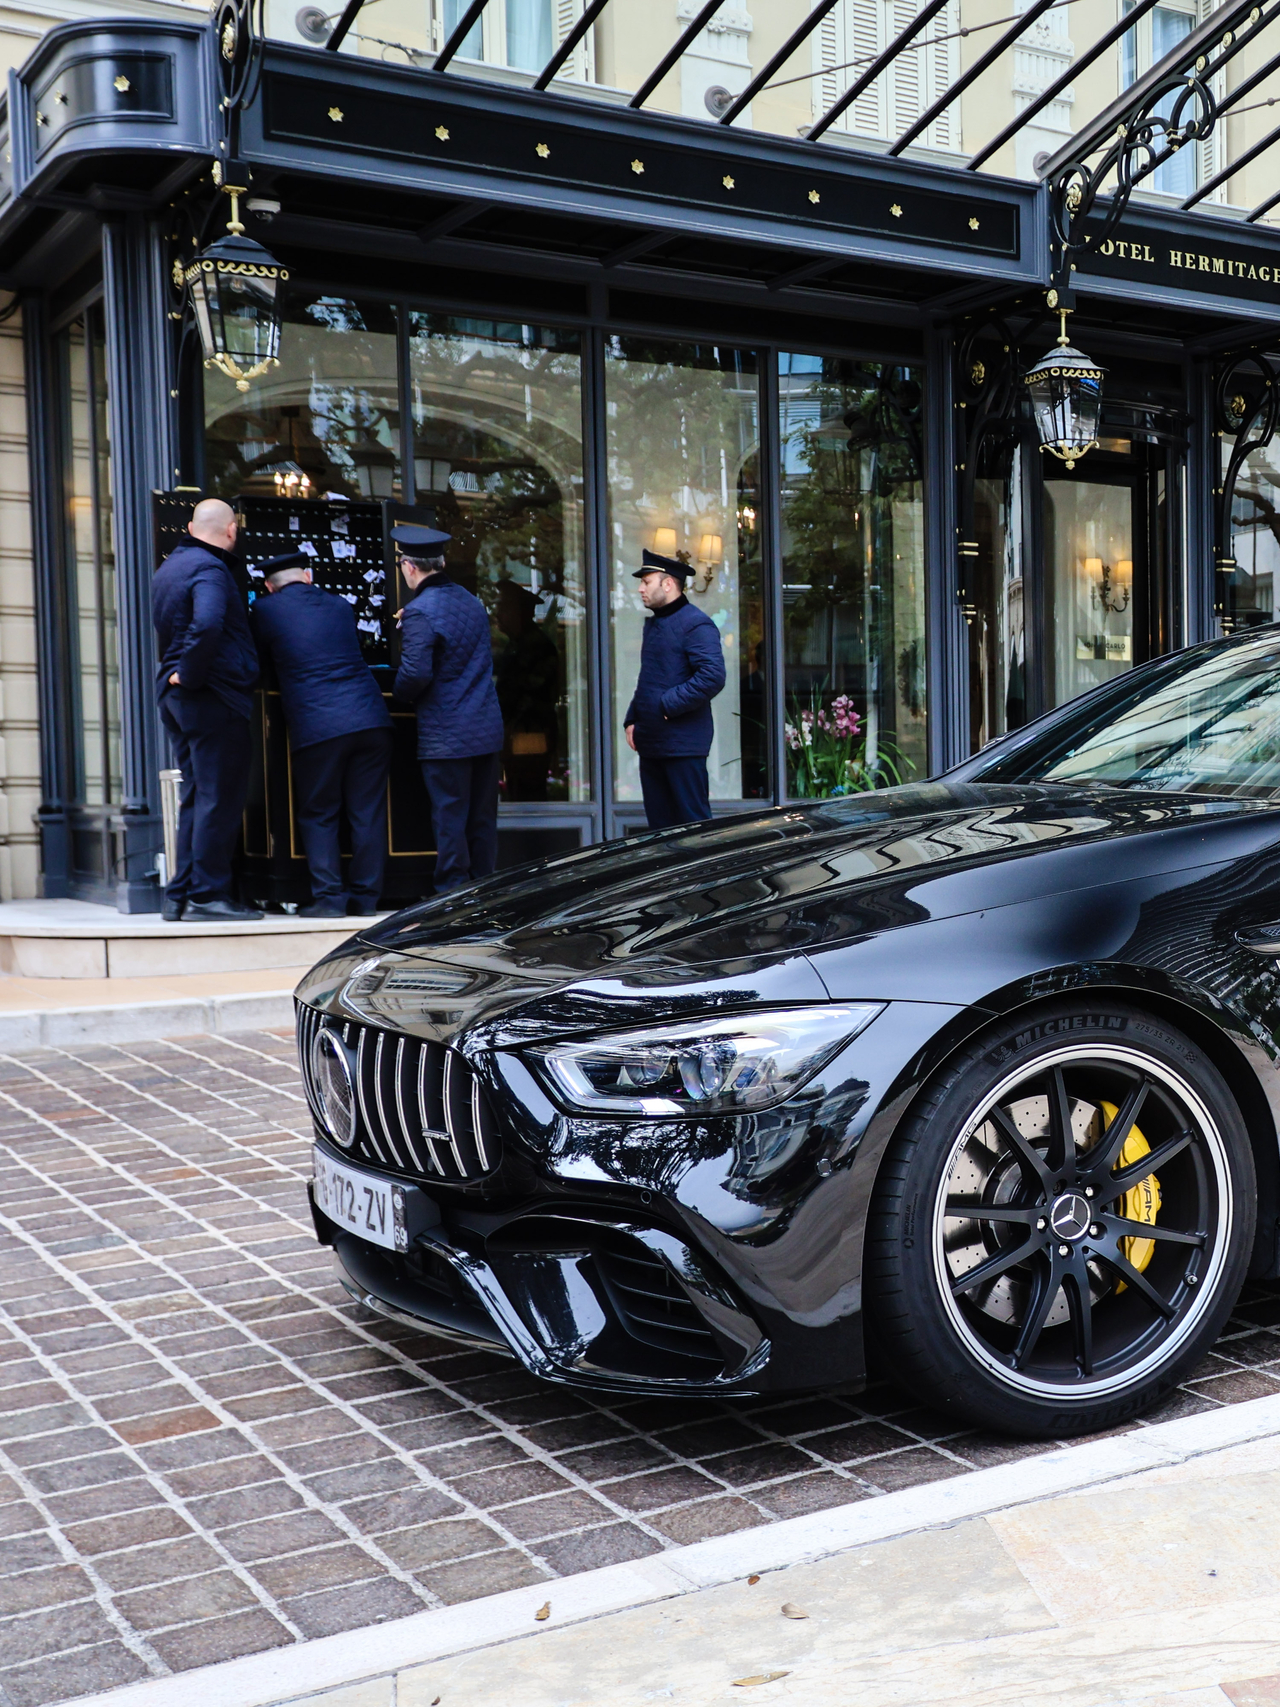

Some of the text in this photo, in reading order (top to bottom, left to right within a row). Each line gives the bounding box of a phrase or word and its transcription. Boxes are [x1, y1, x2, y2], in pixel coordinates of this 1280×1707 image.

[1015, 1015, 1122, 1048] MICHELIN
[1135, 1022, 1163, 1039] 275/35
[1164, 1036, 1176, 1046] ZR
[1143, 1186, 1152, 1222] AM
[394, 1225, 408, 1248] 69
